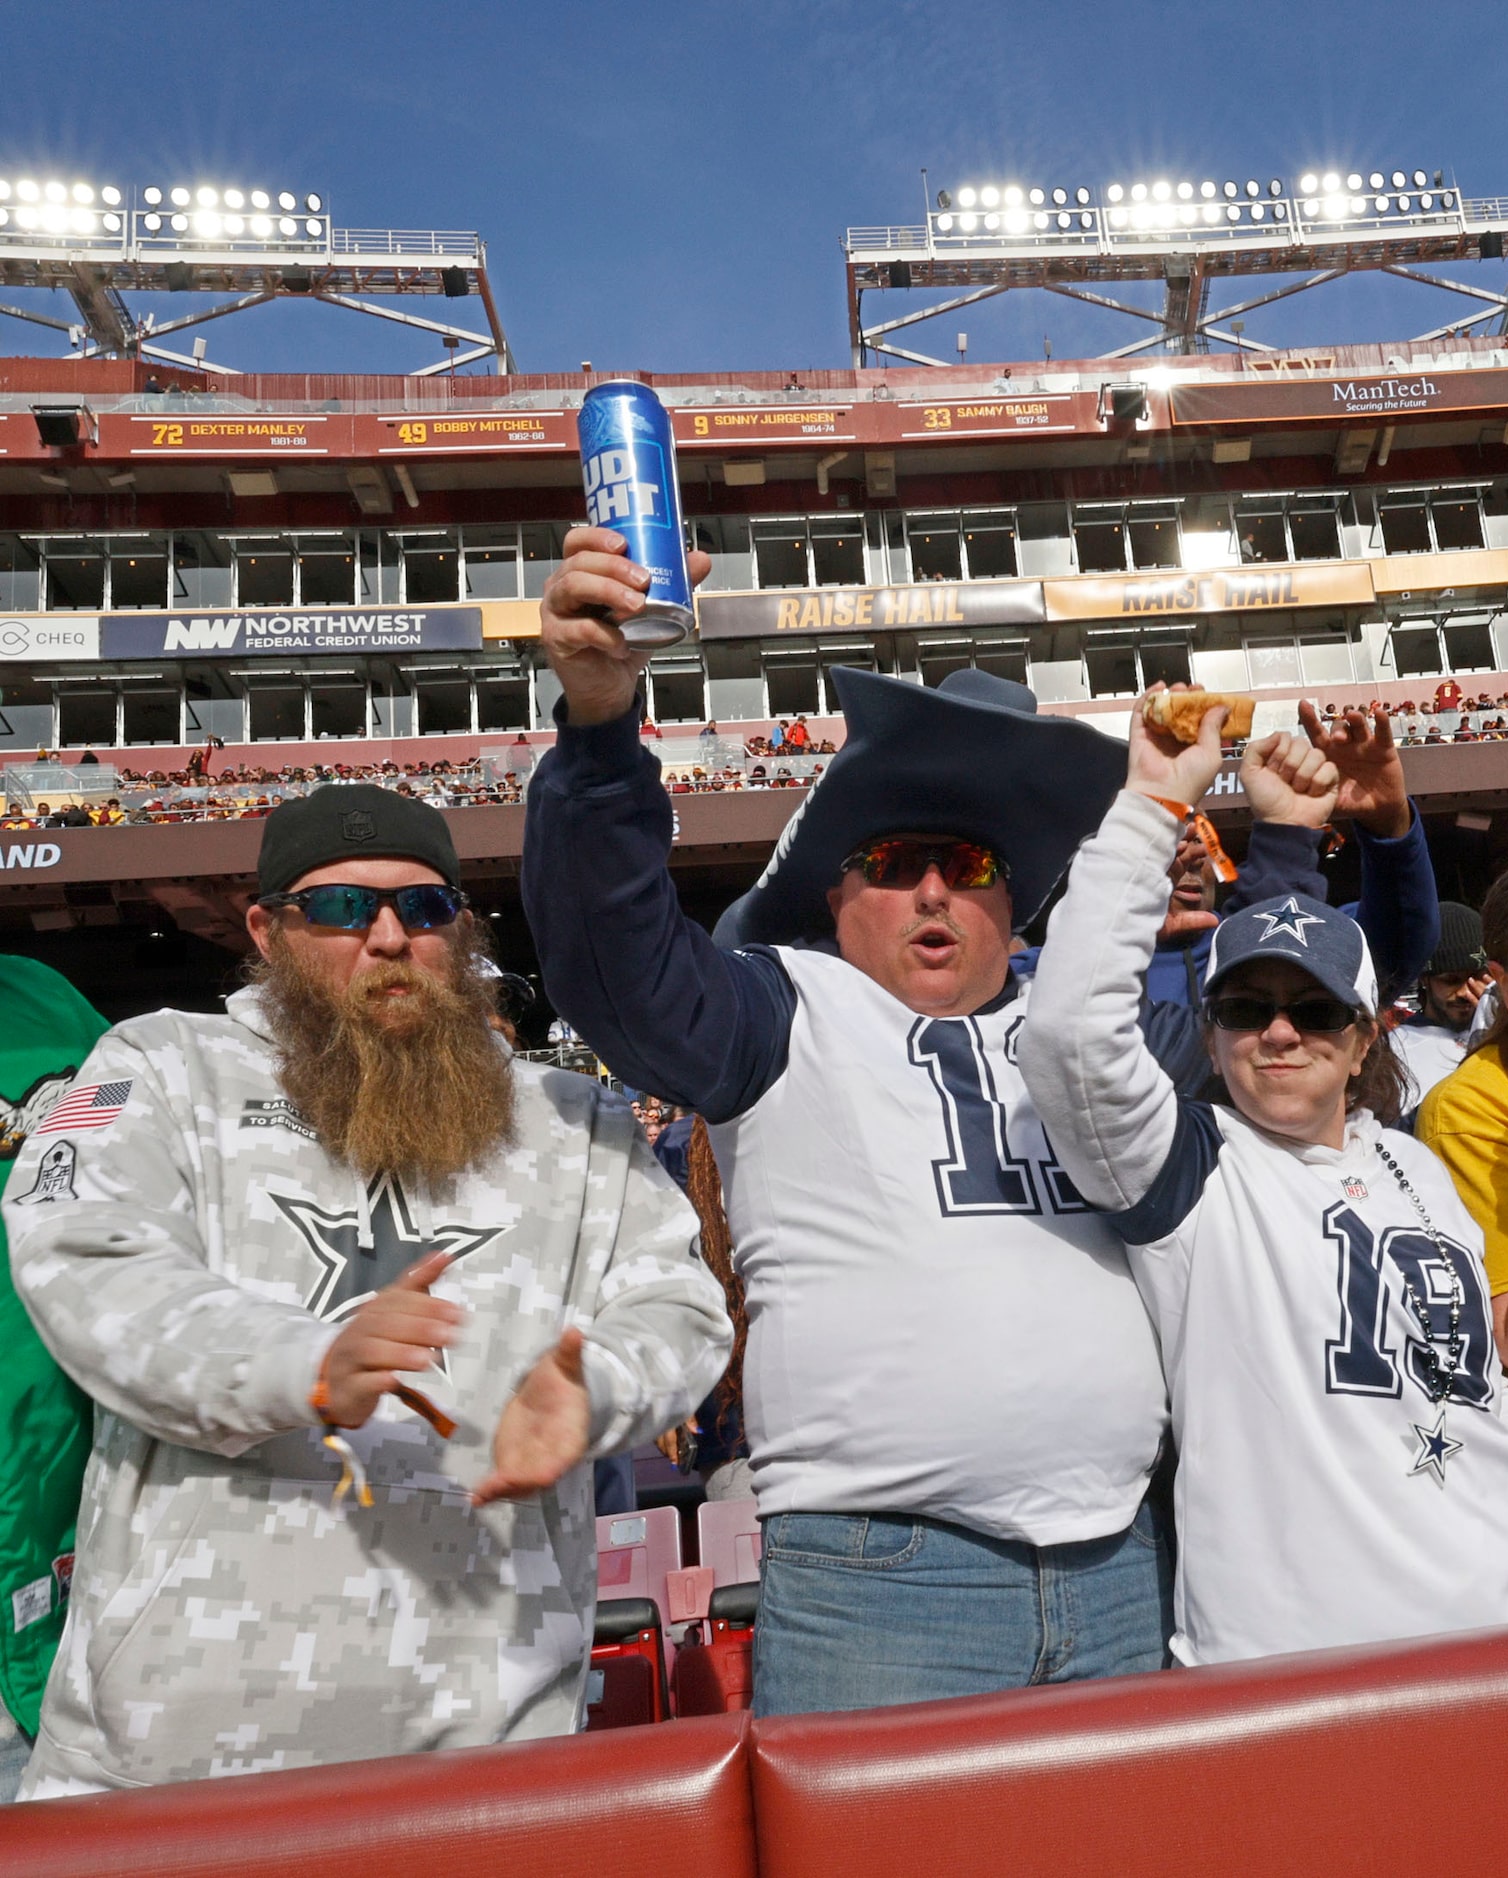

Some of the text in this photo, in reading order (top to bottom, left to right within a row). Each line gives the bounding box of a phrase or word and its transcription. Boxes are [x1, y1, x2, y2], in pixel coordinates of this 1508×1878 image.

[1332, 376, 1437, 401] ManTech
[923, 403, 1048, 429] 33 SAMMY BAUGH
[1346, 399, 1427, 412] Securing the Future
[152, 424, 306, 445] 72 DEXTER MANLEY
[398, 420, 545, 444] 49 BOBBY MITCHELL
[694, 411, 835, 436] 9 SONNY JURGENSEN
[1224, 572, 1299, 607] HAIL
[777, 589, 964, 630] RAISE HAIL
[36, 632, 86, 646] CHEQ
[163, 613, 427, 651] NW NORTHWEST
[245, 633, 422, 649] FEDERAL CREDIT UNION
[262, 1100, 307, 1119] SALUT
[249, 1116, 317, 1140] TO SERVICE
[37, 1178, 66, 1193] NFL
[1346, 1185, 1367, 1197] NFL
[1323, 1200, 1501, 1412] 19
